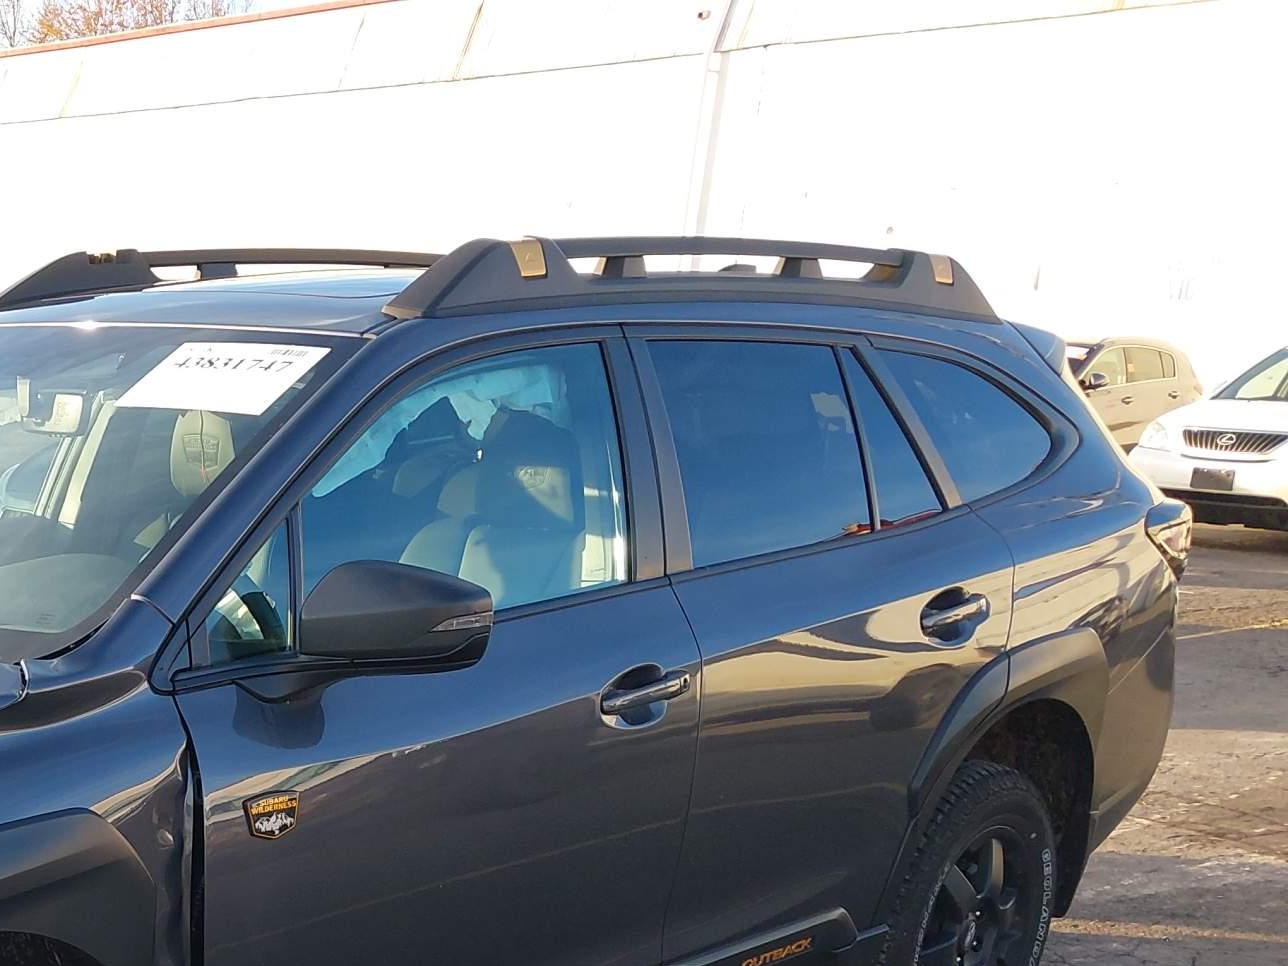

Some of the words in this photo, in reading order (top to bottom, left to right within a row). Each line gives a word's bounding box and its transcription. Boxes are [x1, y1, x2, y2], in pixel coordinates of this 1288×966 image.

[174, 356, 293, 373] 43831747
[251, 800, 297, 815] WILDERNESS
[259, 795, 289, 807] SUBARU
